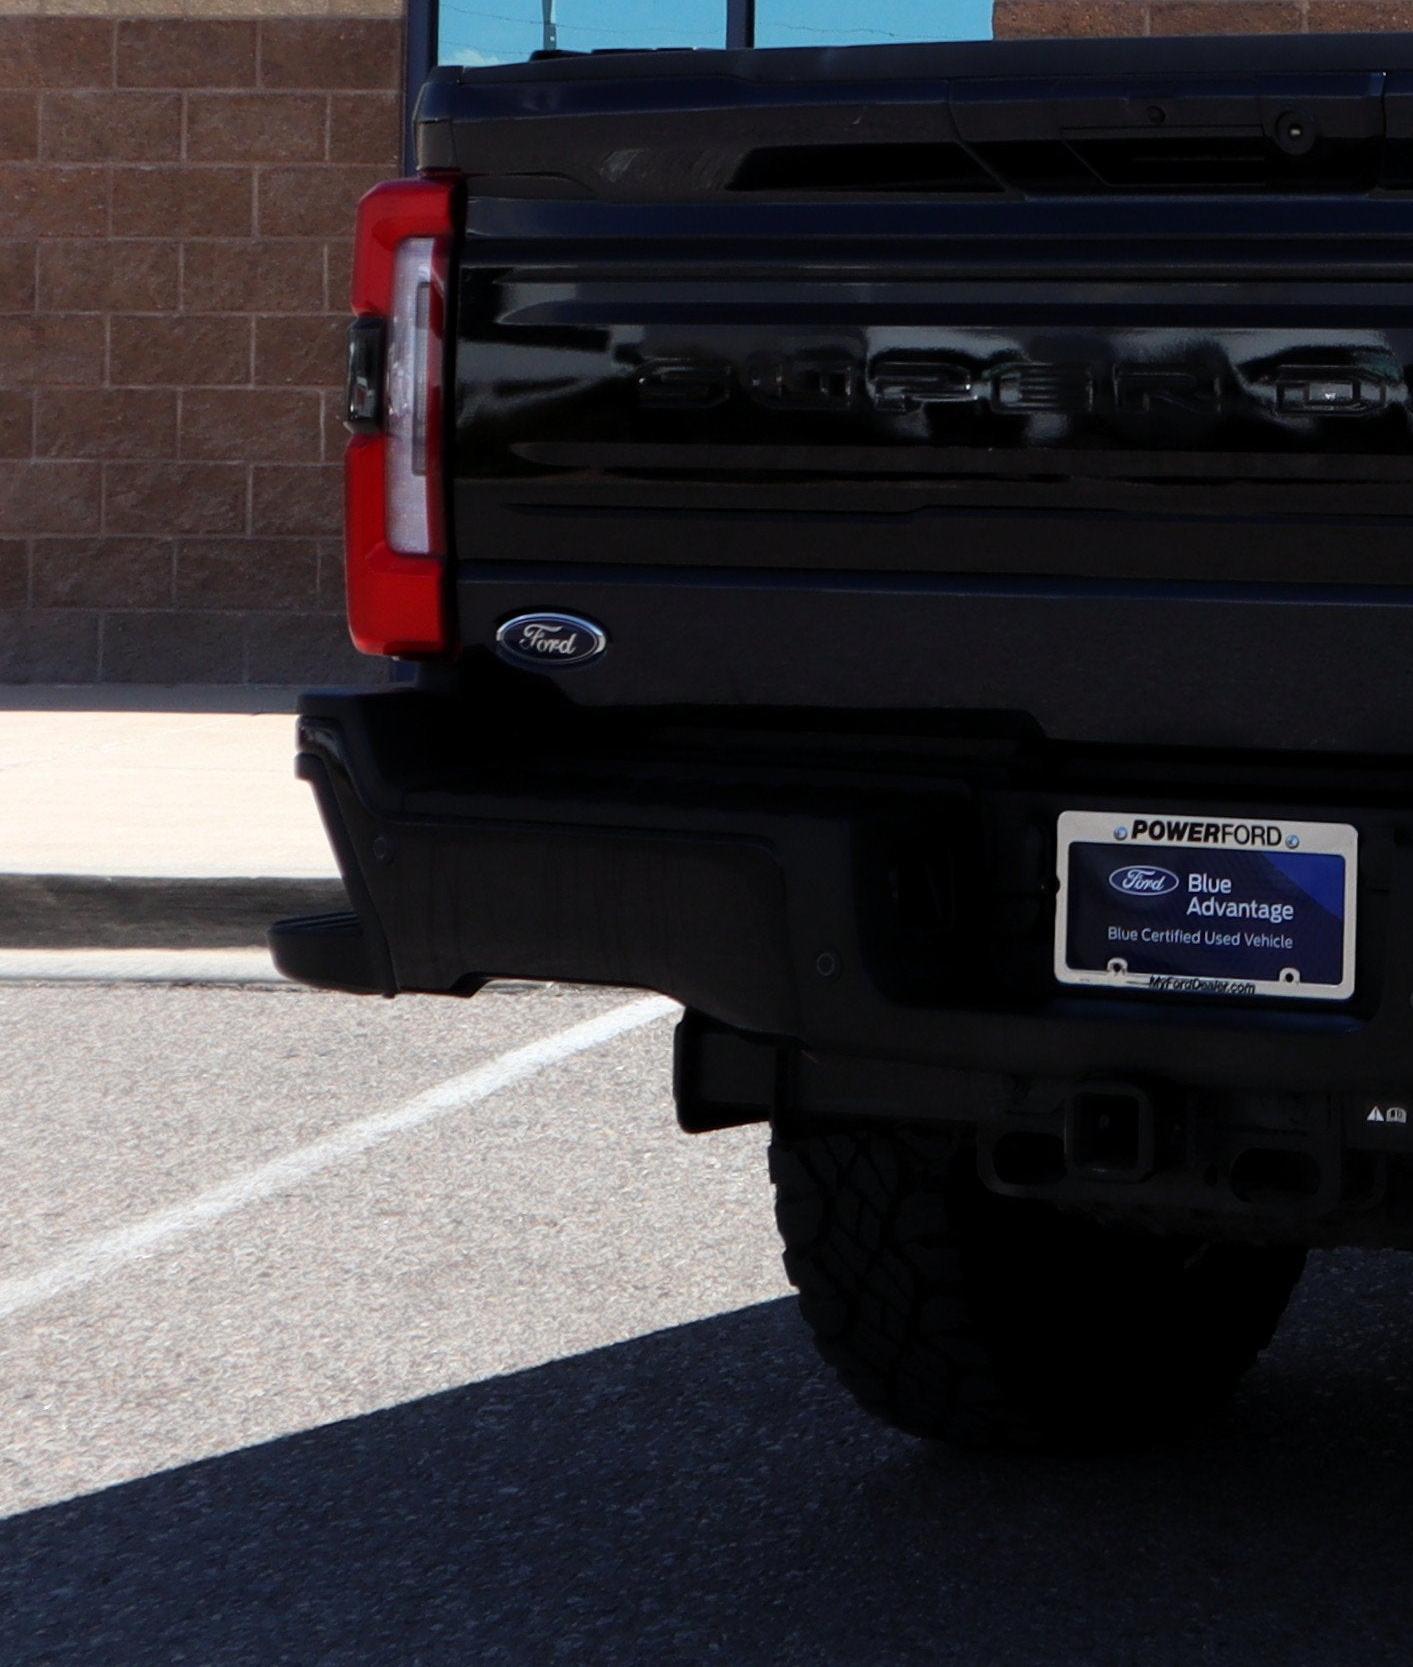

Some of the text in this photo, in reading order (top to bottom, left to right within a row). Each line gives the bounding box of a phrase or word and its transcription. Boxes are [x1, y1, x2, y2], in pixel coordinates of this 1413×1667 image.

[519, 623, 578, 655] Ford
[1121, 868, 1166, 893] Ford
[1187, 873, 1232, 894] Blue
[1186, 896, 1294, 923] Advantage
[1107, 926, 1293, 949] Blue Certified Used Vehicle
